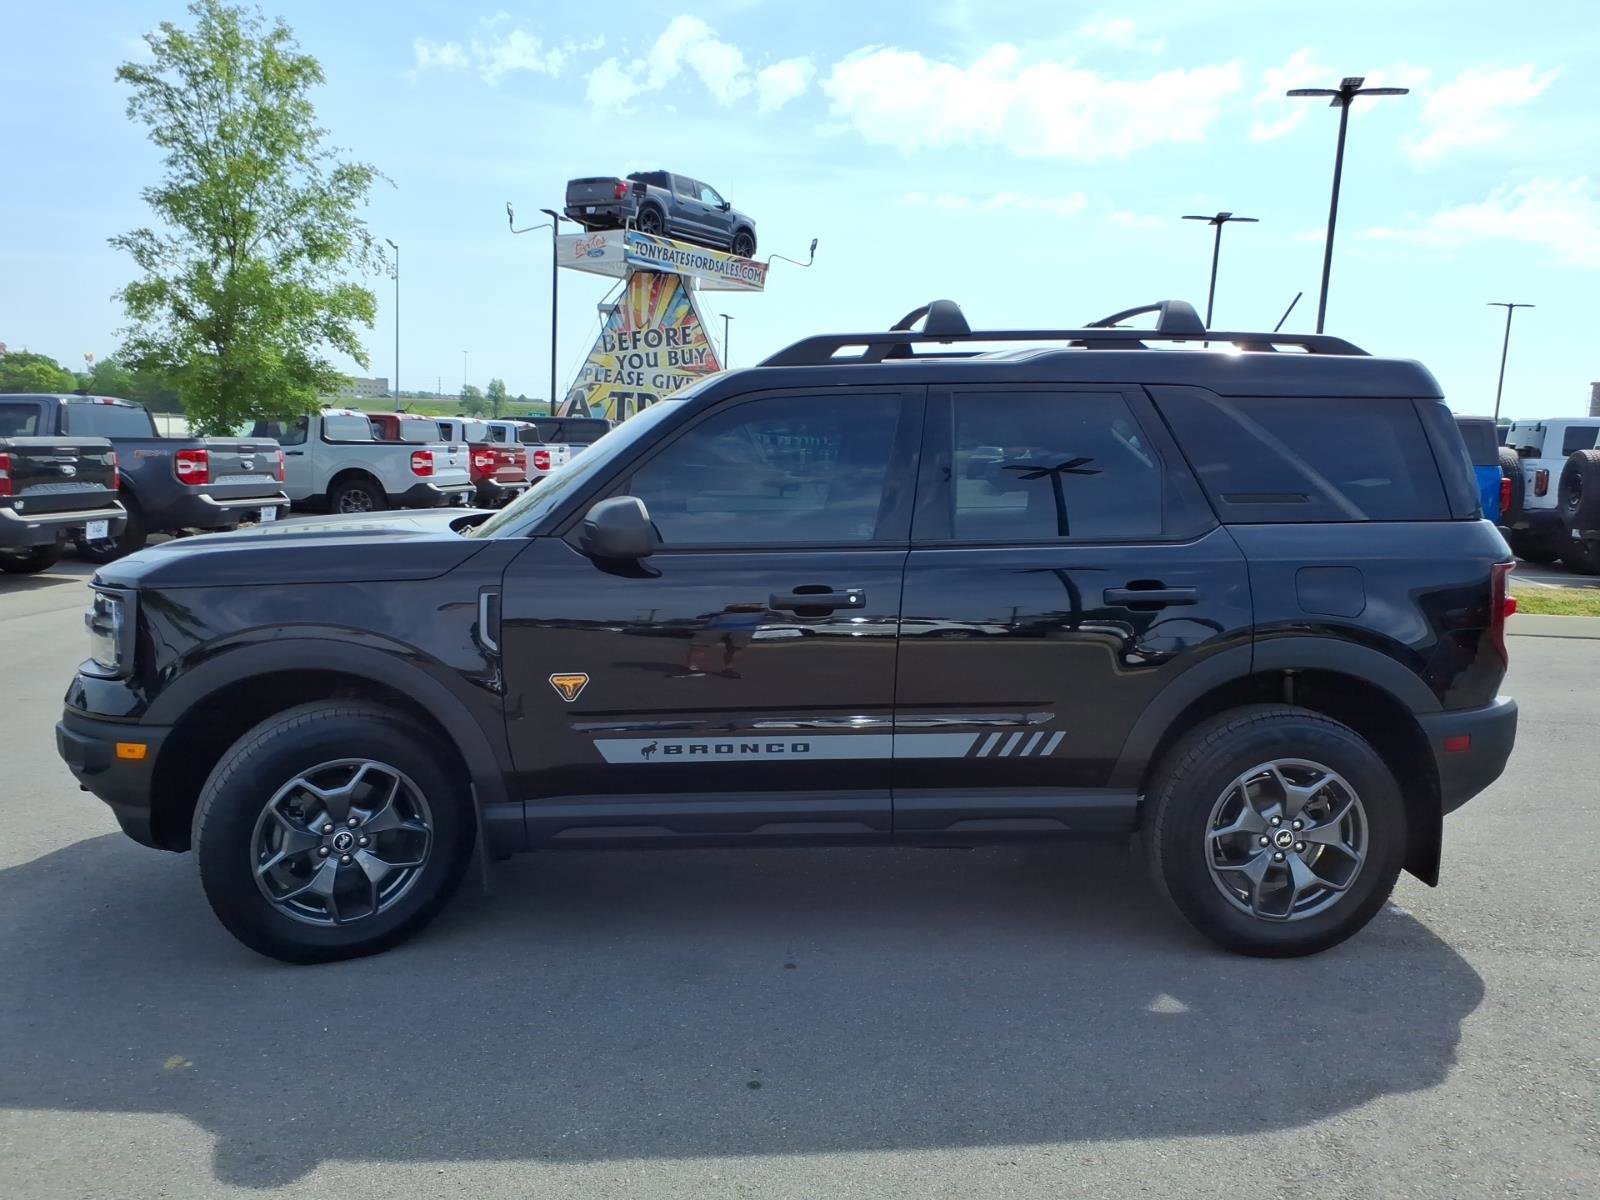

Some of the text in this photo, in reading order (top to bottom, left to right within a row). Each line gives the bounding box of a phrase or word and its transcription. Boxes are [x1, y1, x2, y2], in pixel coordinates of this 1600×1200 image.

[602, 326, 693, 352] BEFORE
[616, 348, 707, 370] YOU BUY
[584, 367, 645, 387] PLEASE
[565, 389, 592, 418] A
[663, 743, 810, 755] BRONCO
